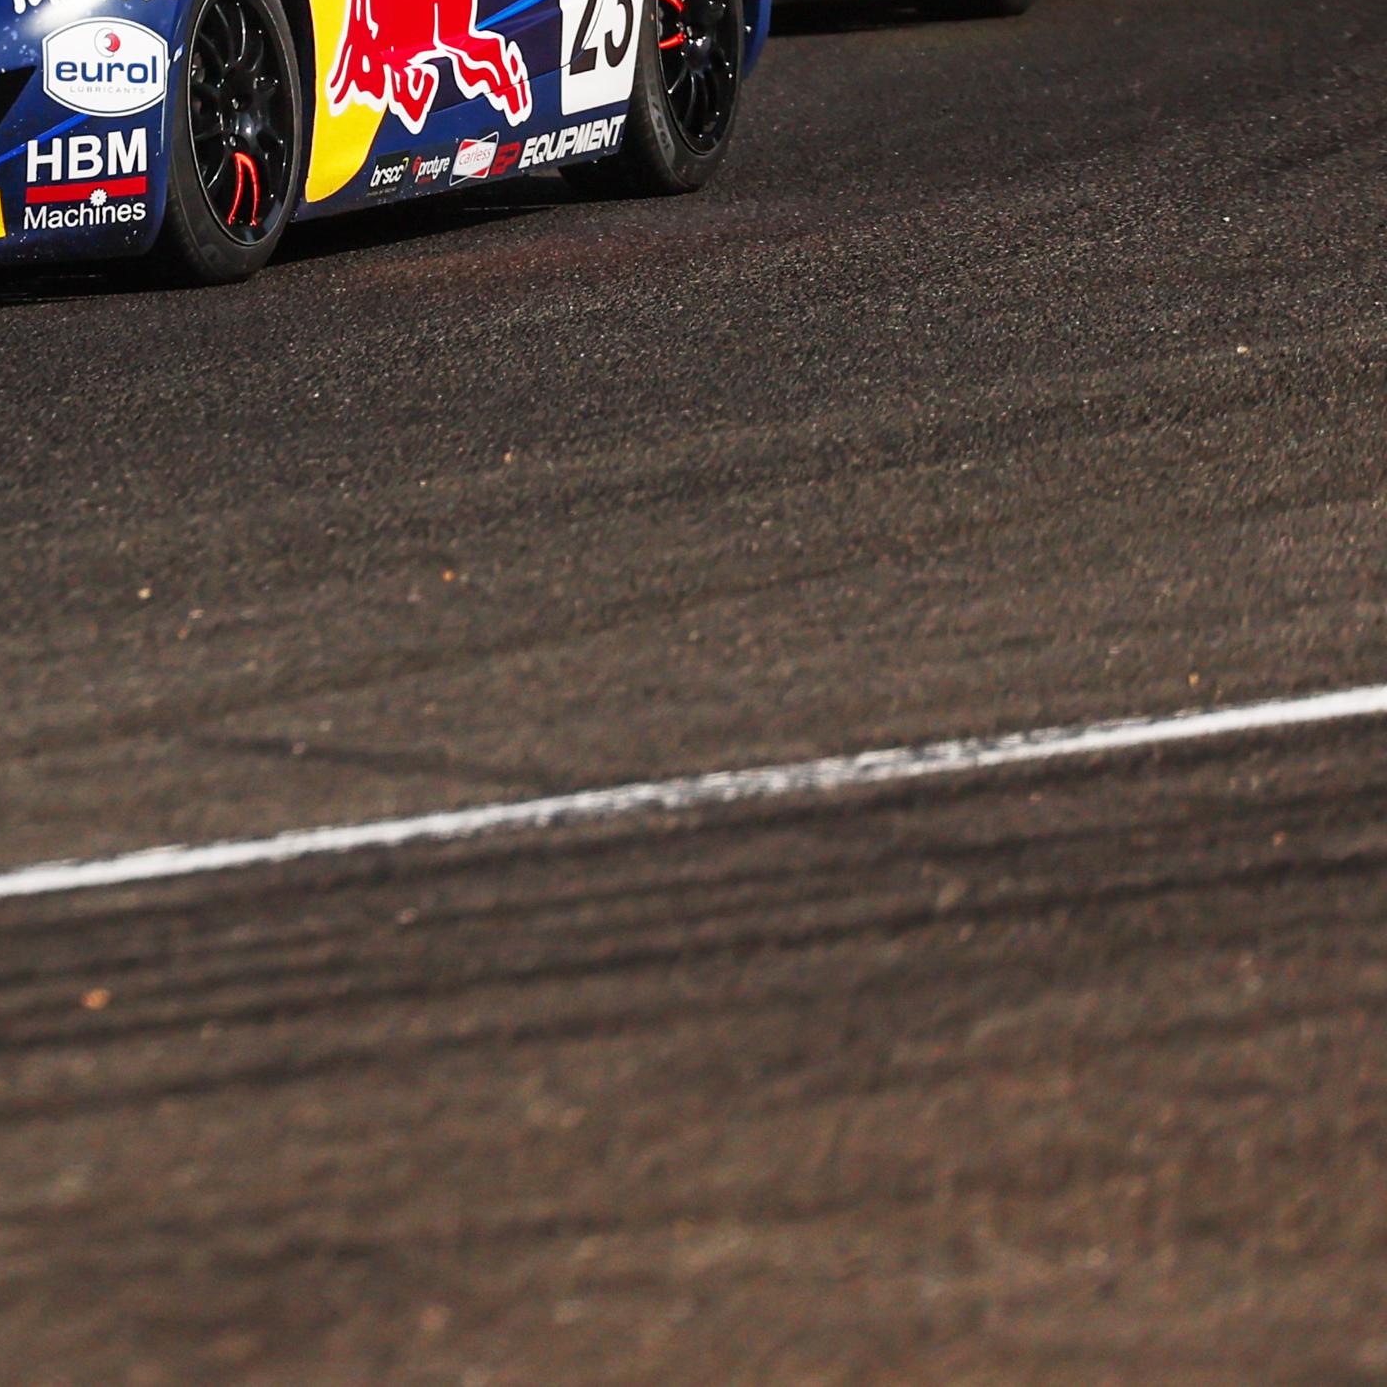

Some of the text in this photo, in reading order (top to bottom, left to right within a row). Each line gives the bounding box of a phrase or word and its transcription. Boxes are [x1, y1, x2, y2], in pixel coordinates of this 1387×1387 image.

[55, 56, 158, 85] eurol
[69, 85, 146, 95] LUBRICANTS
[26, 127, 148, 183] HBM
[518, 114, 627, 169] EQUIPMENT
[415, 156, 451, 182] protyre
[458, 146, 492, 166] carless
[370, 164, 405, 188] brscc
[23, 198, 147, 231] Machines
